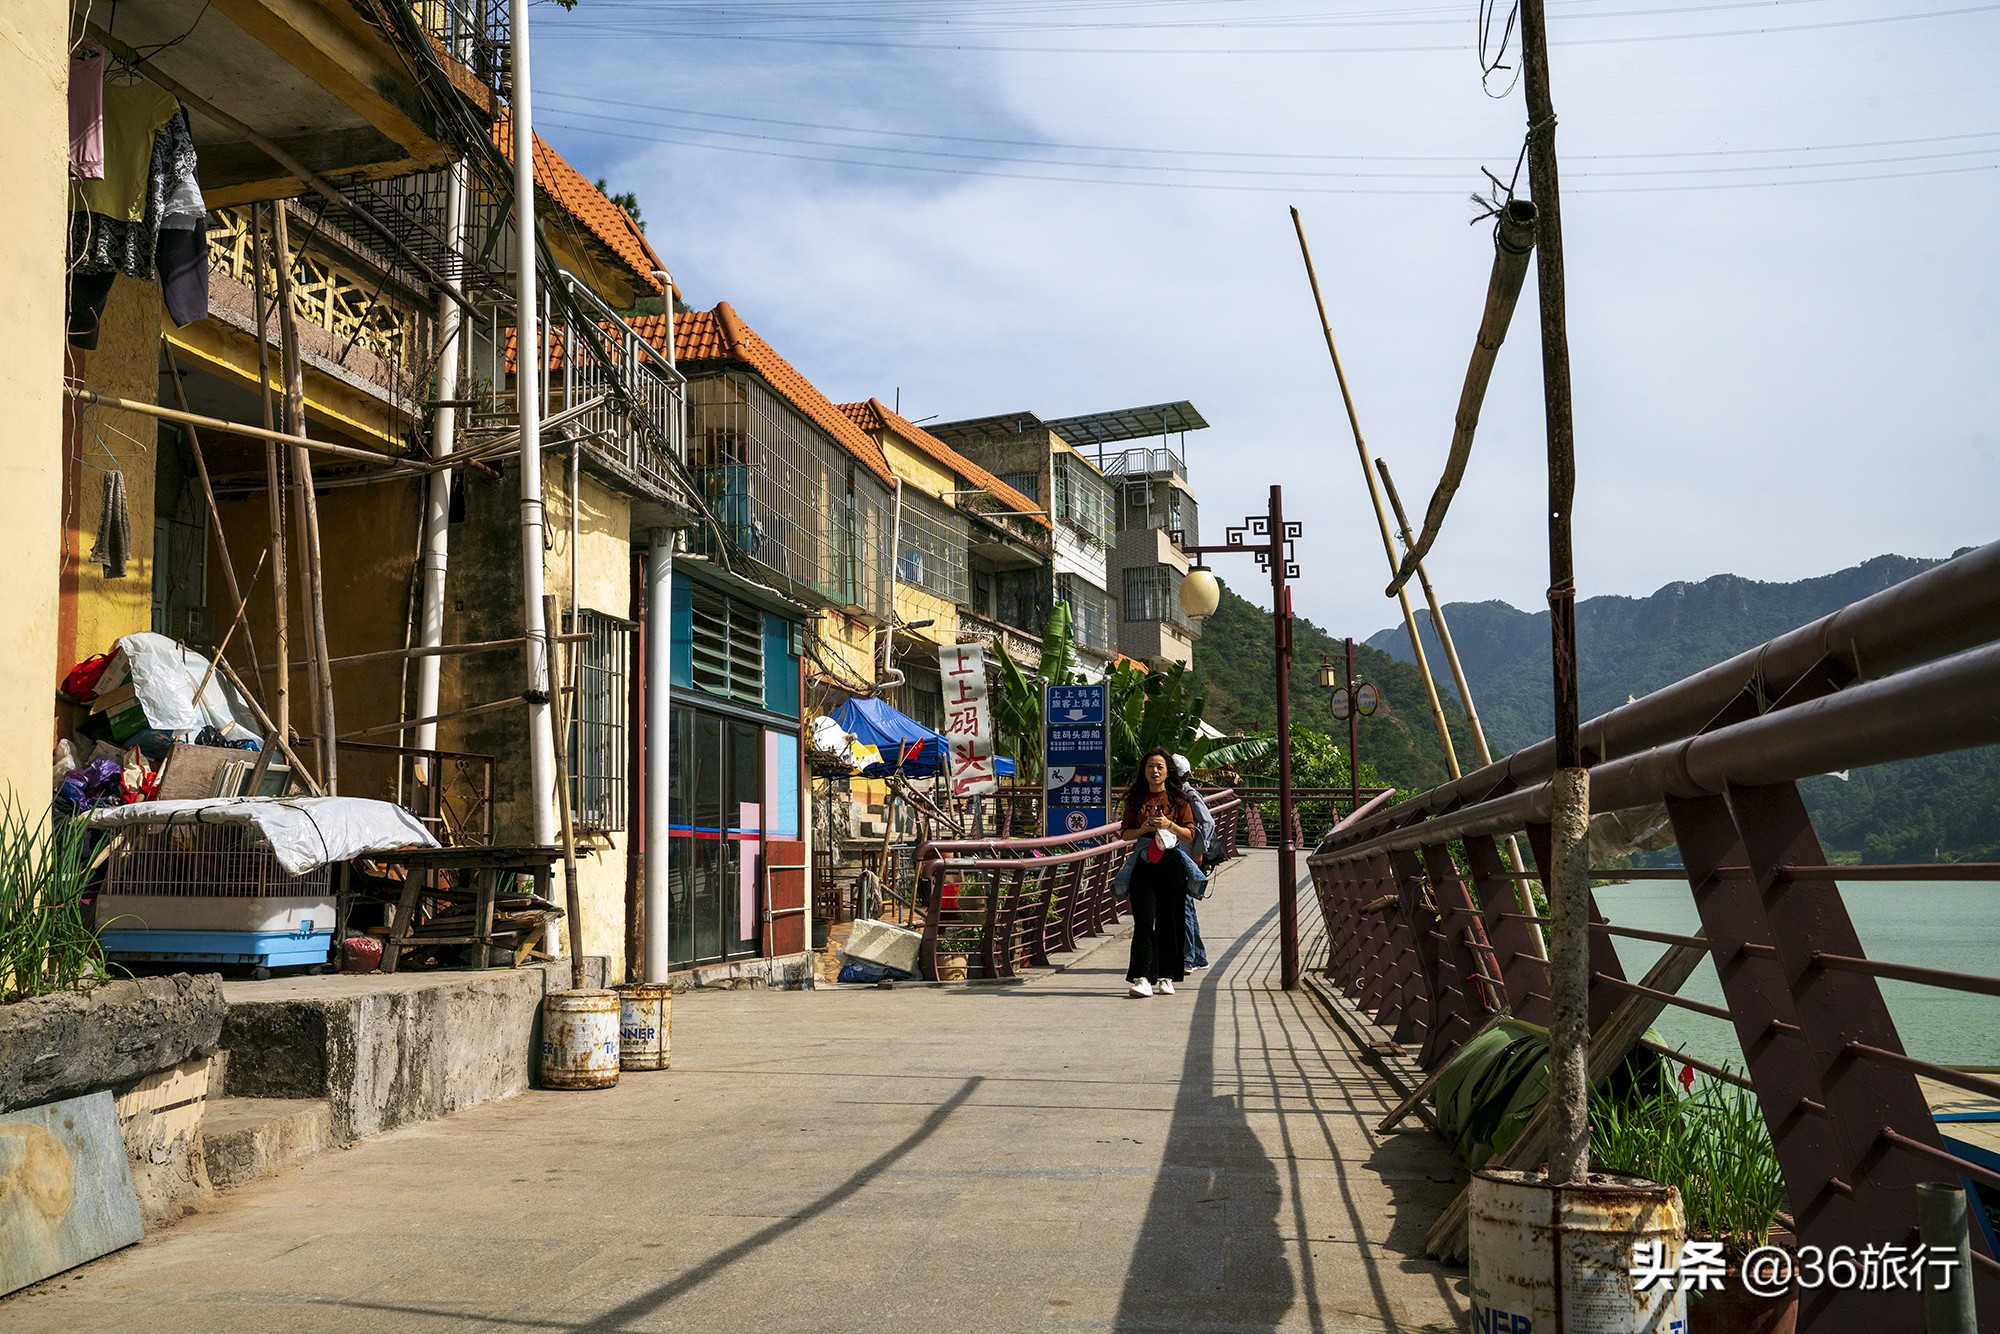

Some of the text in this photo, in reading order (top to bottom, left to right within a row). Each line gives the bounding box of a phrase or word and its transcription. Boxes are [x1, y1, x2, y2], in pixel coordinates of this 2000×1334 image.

[1051, 689, 1101, 699] 上上码头
[1051, 699, 1101, 709] 旅客上落点
[948, 648, 987, 776] 上上码头
[1060, 786, 1102, 795] 上落游客
[1060, 795, 1102, 804] 注意安全
